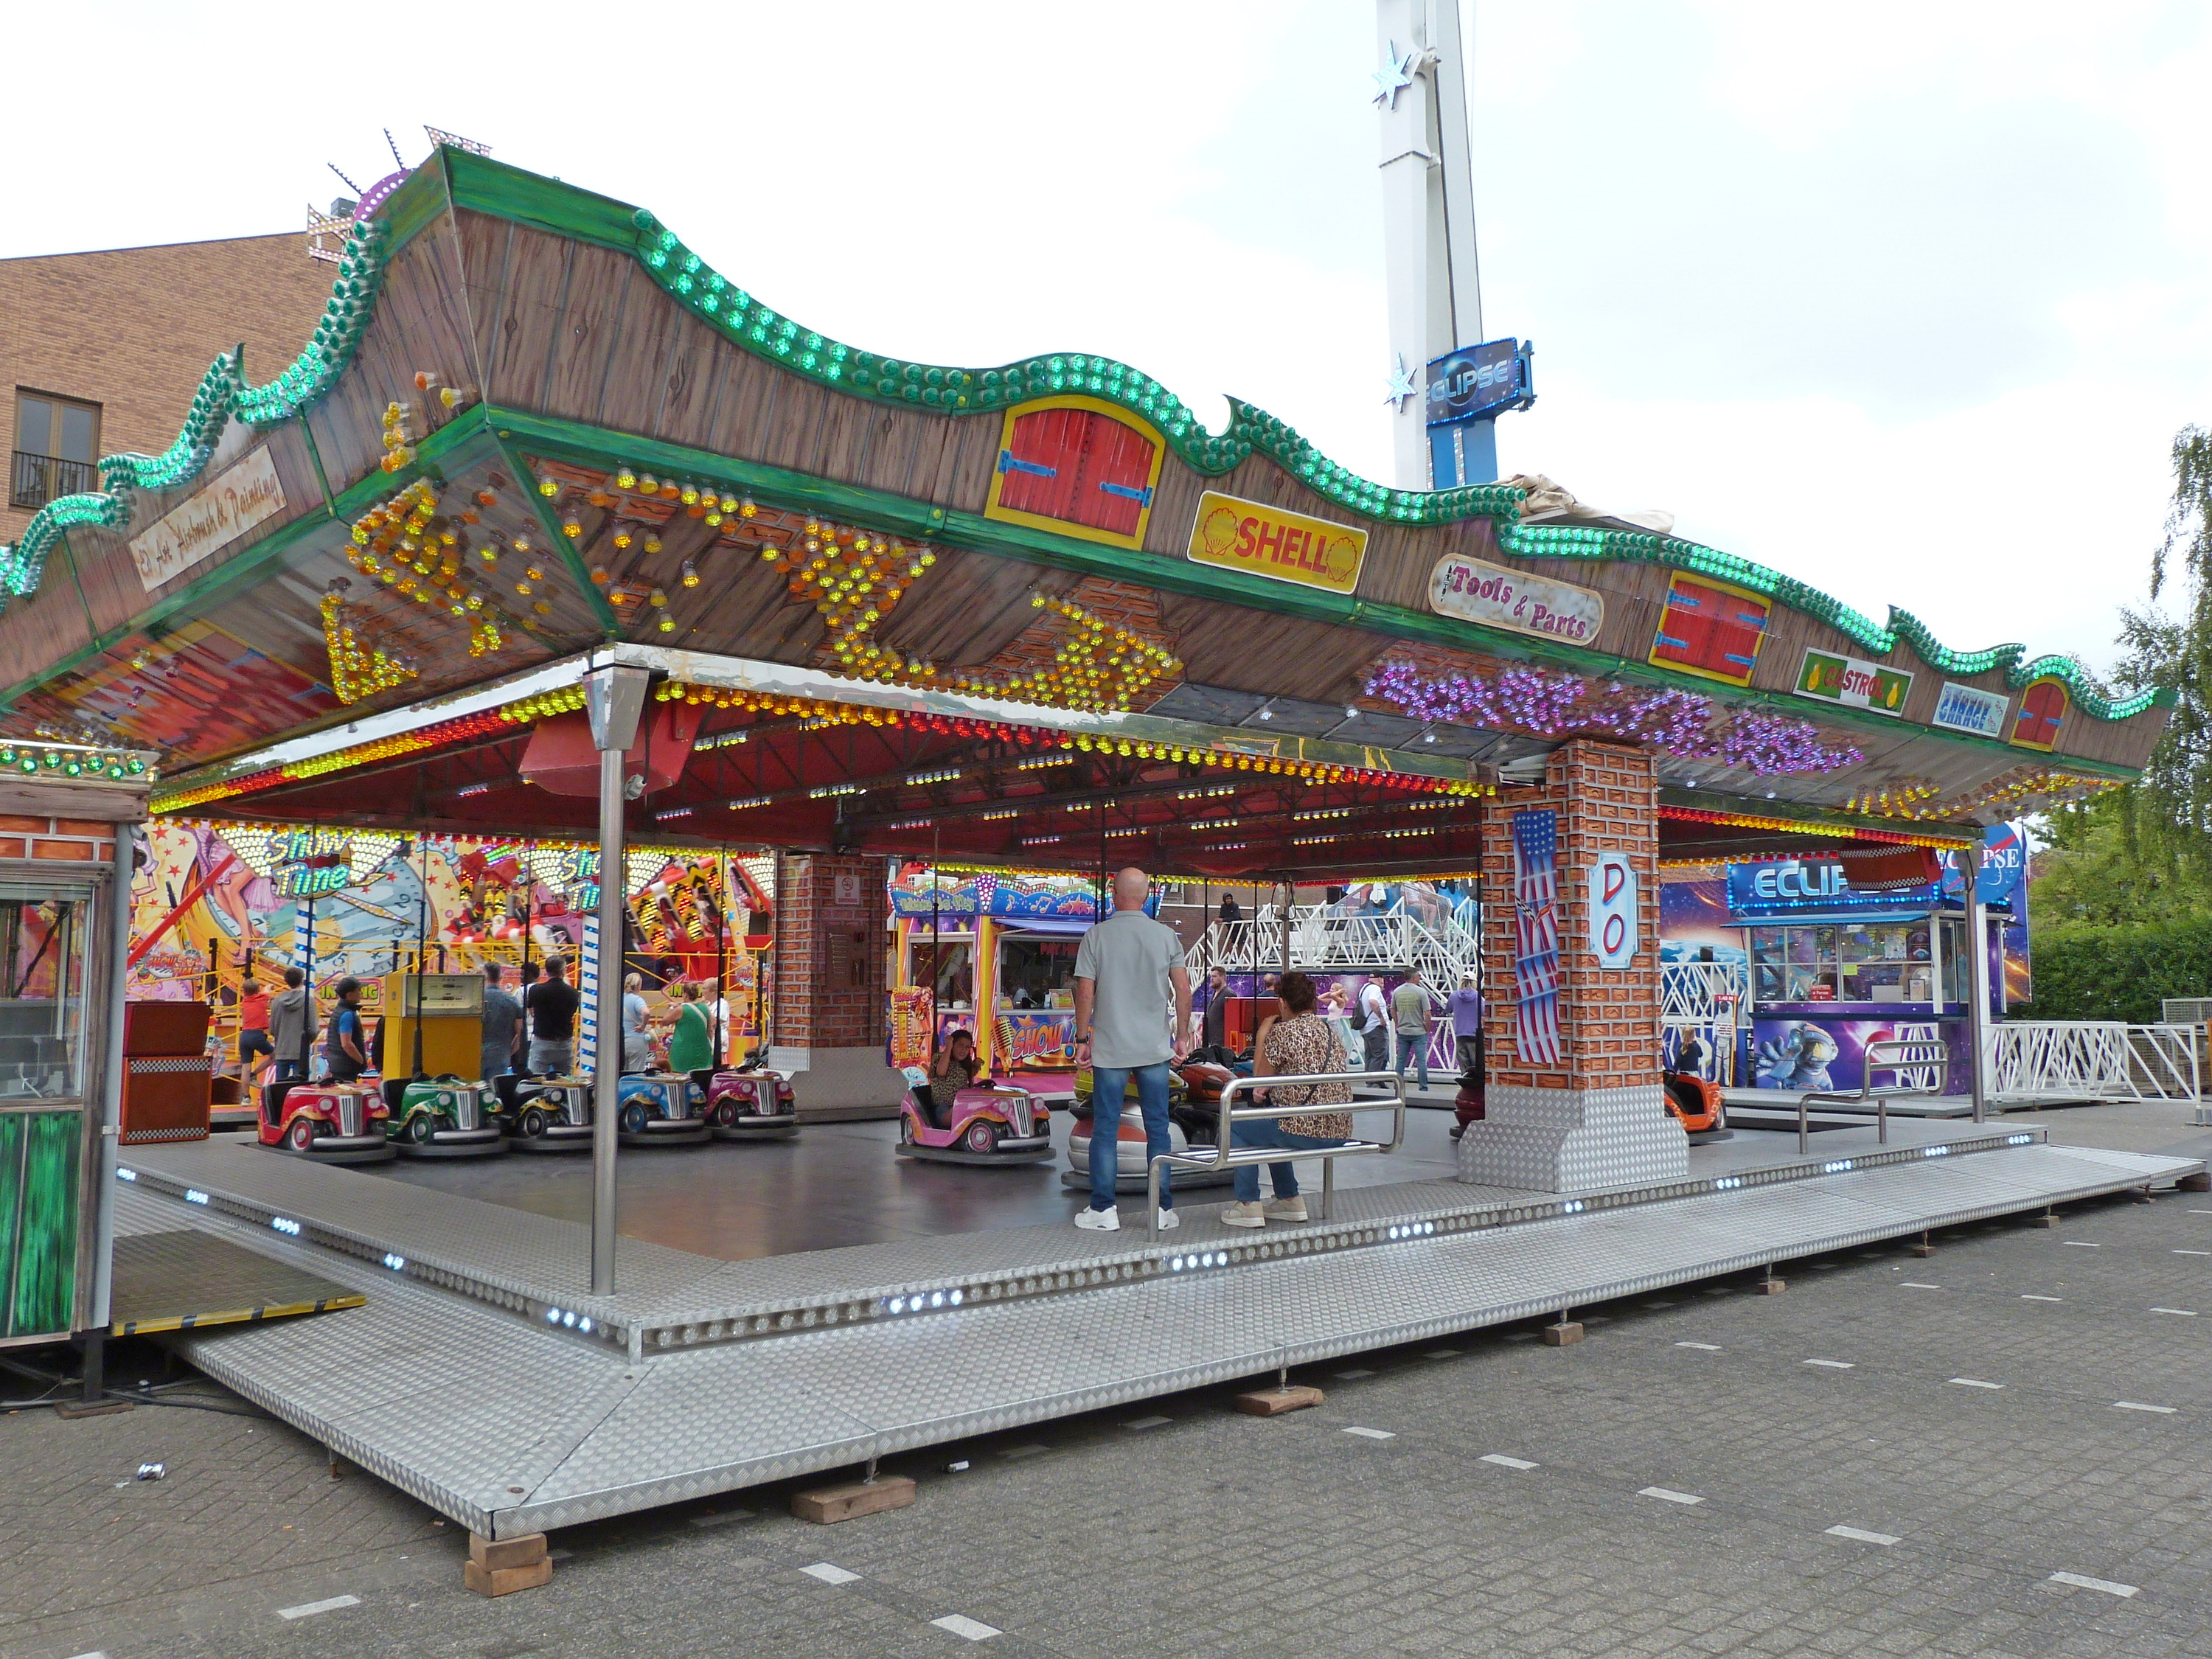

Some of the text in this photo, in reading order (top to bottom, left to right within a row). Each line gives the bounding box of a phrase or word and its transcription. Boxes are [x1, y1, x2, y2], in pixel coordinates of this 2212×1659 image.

[224, 473, 281, 532] Painting
[1234, 516, 1328, 574] SHELL
[1452, 566, 1587, 639] Tools & Parts
[1823, 665, 1885, 700] CASTROL
[1938, 691, 1992, 730] GARAGE
[272, 863, 350, 897] Time
[558, 848, 602, 883] Sho
[1754, 865, 1910, 899] ECLIP
[1012, 1023, 1064, 1059] SHOW
